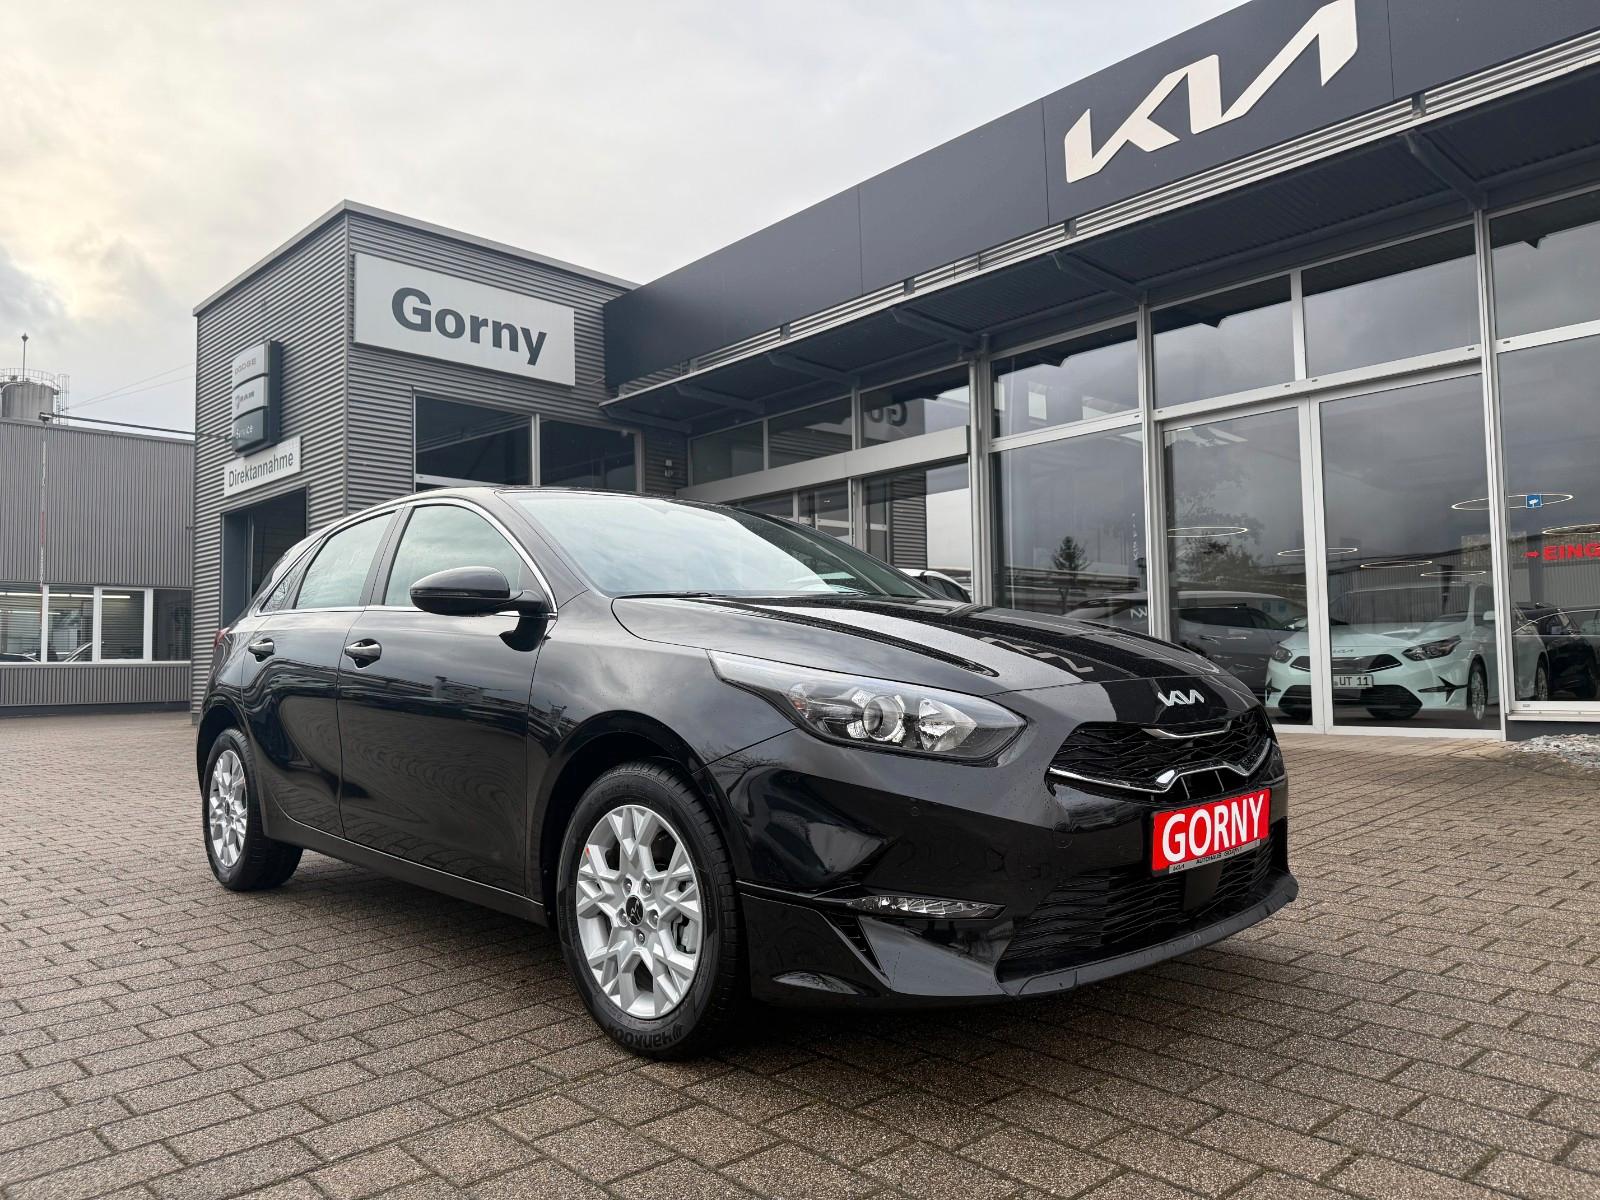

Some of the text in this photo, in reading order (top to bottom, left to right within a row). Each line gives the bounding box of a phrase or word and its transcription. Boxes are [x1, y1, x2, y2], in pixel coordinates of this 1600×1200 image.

[1064, 0, 1358, 184] KIA
[391, 287, 547, 366] Gorny
[228, 452, 294, 487] Direktannahme
[1157, 689, 1205, 707] KIA
[1339, 676, 1369, 686] UT 11
[1162, 794, 1264, 862] GORNY
